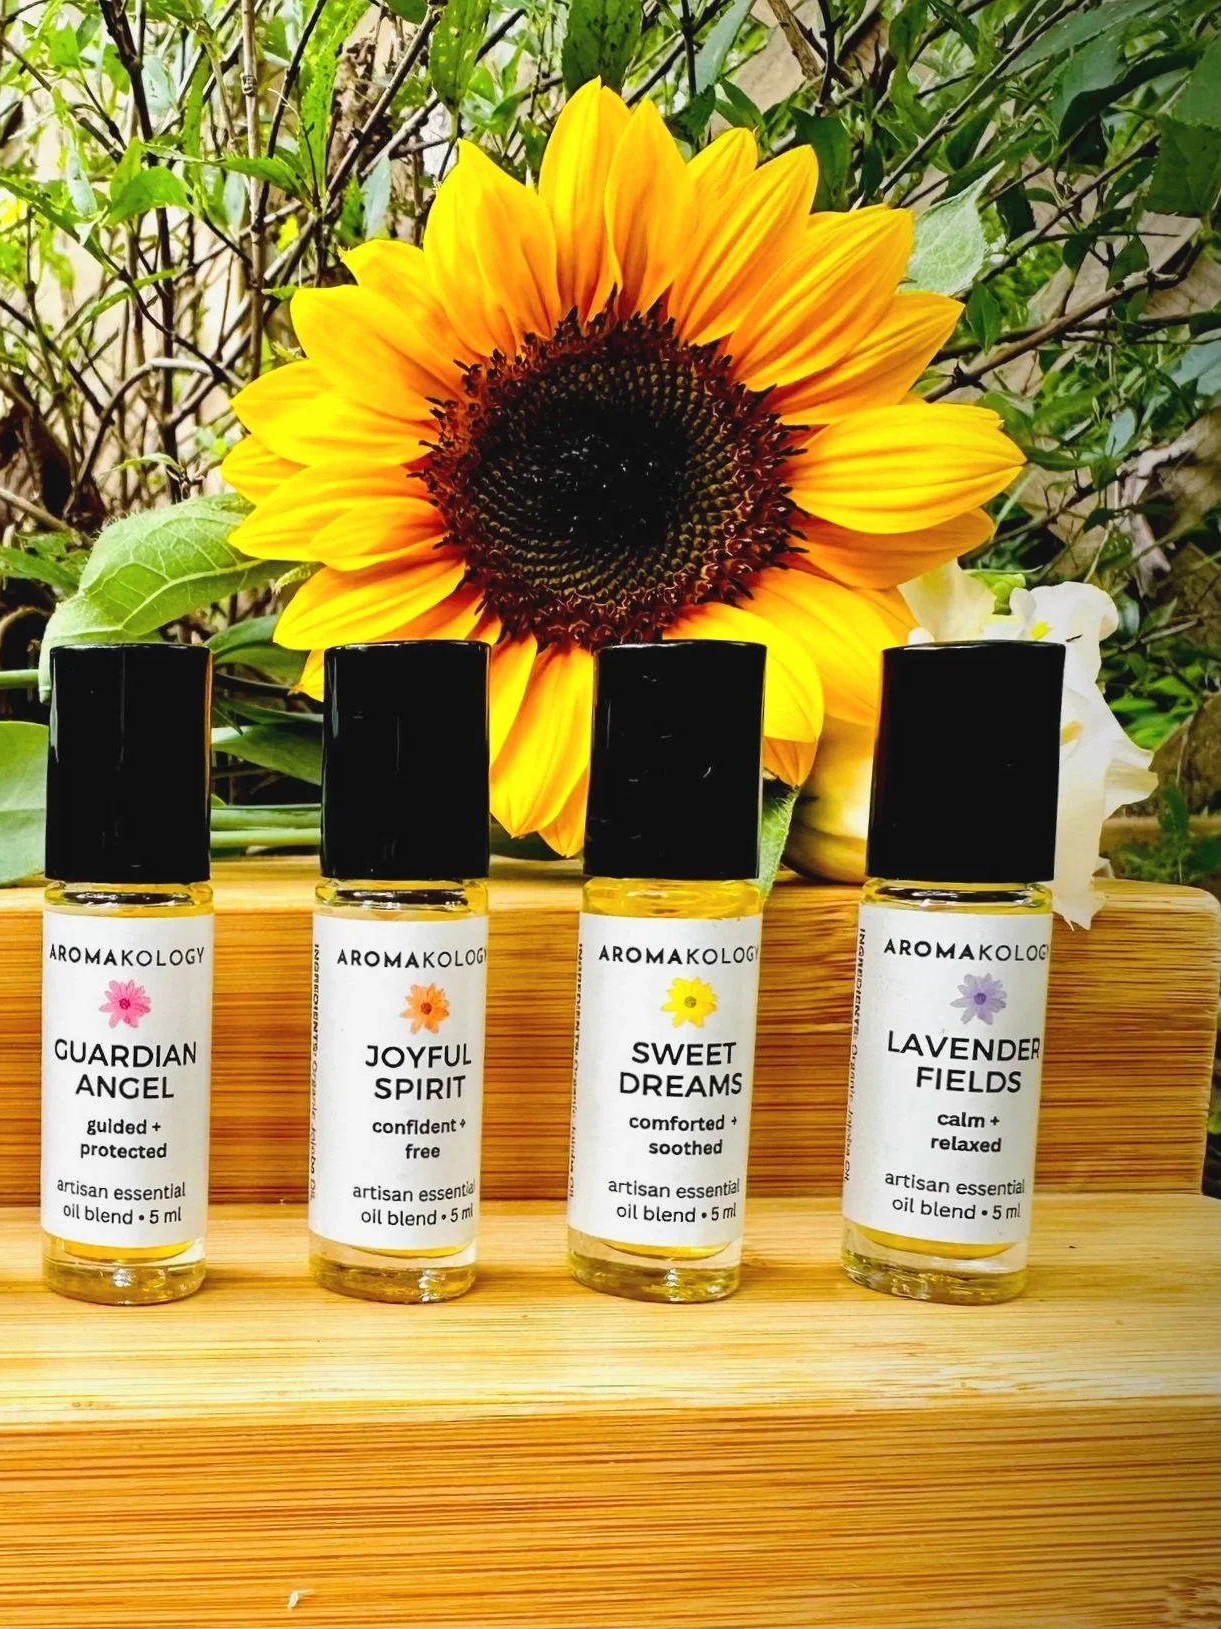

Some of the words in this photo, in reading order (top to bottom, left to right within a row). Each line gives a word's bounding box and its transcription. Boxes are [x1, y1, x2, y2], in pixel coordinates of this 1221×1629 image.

[50, 944, 204, 966] AROMAKOLOGY
[884, 938, 1049, 962] AROMAKOLOG
[55, 1038, 197, 1068] GUARDIAN
[365, 1044, 472, 1068] JOYFUL
[632, 1042, 737, 1066] SWEET
[887, 1030, 1040, 1061] LAVENDER
[75, 1074, 174, 1099] ANGEL
[375, 1076, 466, 1100] SPIRIT
[619, 1072, 742, 1097] DREAMS
[916, 1067, 1022, 1093] FIELDS
[87, 1118, 147, 1135] guided
[151, 1122, 161, 1132] +
[372, 1119, 456, 1134] confident
[460, 1119, 466, 1129] +
[629, 1114, 725, 1131] comforted
[730, 1117, 737, 1126] +
[937, 1112, 985, 1128] calm
[990, 1116, 1000, 1126] +
[80, 1143, 167, 1158] protected
[405, 1144, 440, 1159] free
[649, 1140, 723, 1156] soothed
[931, 1136, 1002, 1152] relaxed
[57, 1178, 108, 1199] artisan
[113, 1182, 186, 1201] essential
[353, 1184, 413, 1202] artisan
[418, 1180, 475, 1202] essential
[608, 1178, 670, 1198] artisan
[676, 1178, 740, 1198] essential
[885, 1173, 950, 1194] artisan
[956, 1178, 1025, 1196] essential
[63, 1204, 80, 1220] oil
[85, 1207, 133, 1224] blend
[149, 1209, 159, 1224] 5
[164, 1206, 182, 1222] ml
[361, 1209, 382, 1224] oil
[388, 1210, 437, 1226] blend
[450, 1208, 459, 1223] 5
[462, 1206, 473, 1220] ml
[617, 1204, 638, 1220] oil
[643, 1205, 696, 1223] blend
[711, 1206, 719, 1221] 5
[723, 1203, 736, 1219] ml
[892, 1198, 914, 1214] oil
[921, 1200, 976, 1220] blend
[992, 1205, 1002, 1219] 5
[1006, 1203, 1021, 1219] ml
